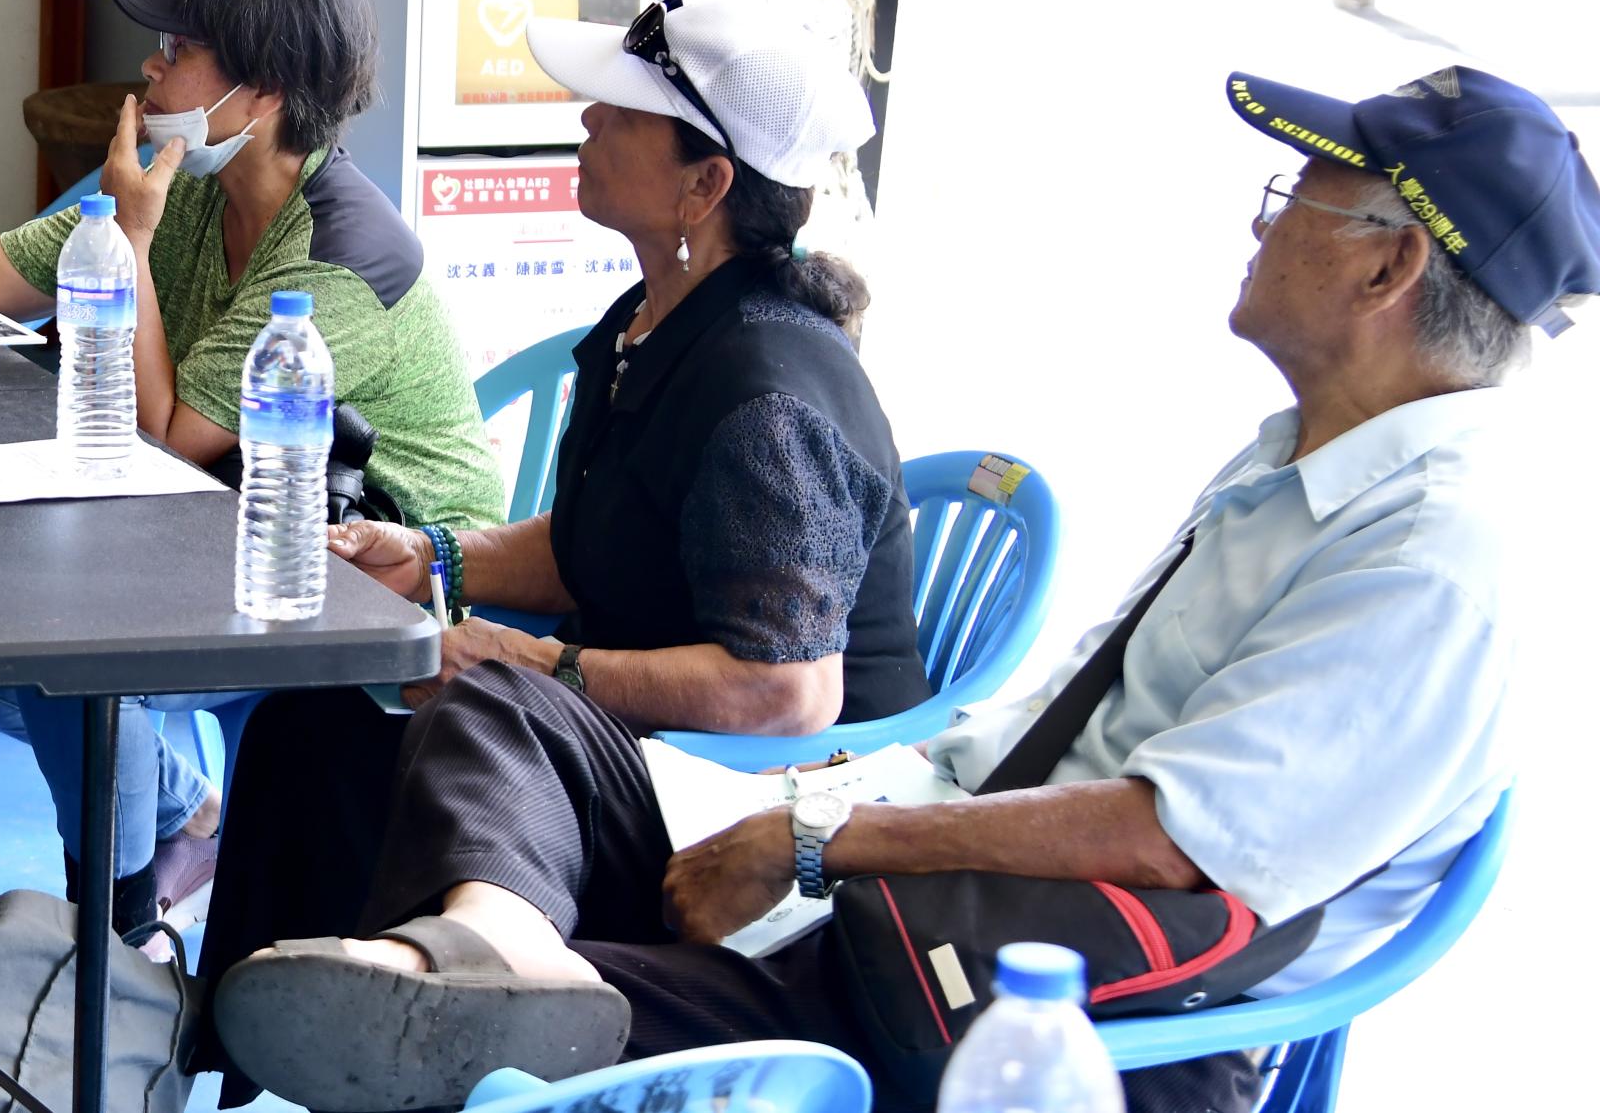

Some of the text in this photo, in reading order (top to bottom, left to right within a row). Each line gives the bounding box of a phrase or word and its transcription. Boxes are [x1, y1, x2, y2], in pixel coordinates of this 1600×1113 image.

[480, 58, 525, 76] AED
[1231, 79, 1366, 168] NCO SCHOOL
[1384, 161, 1469, 255] 入學29週年
